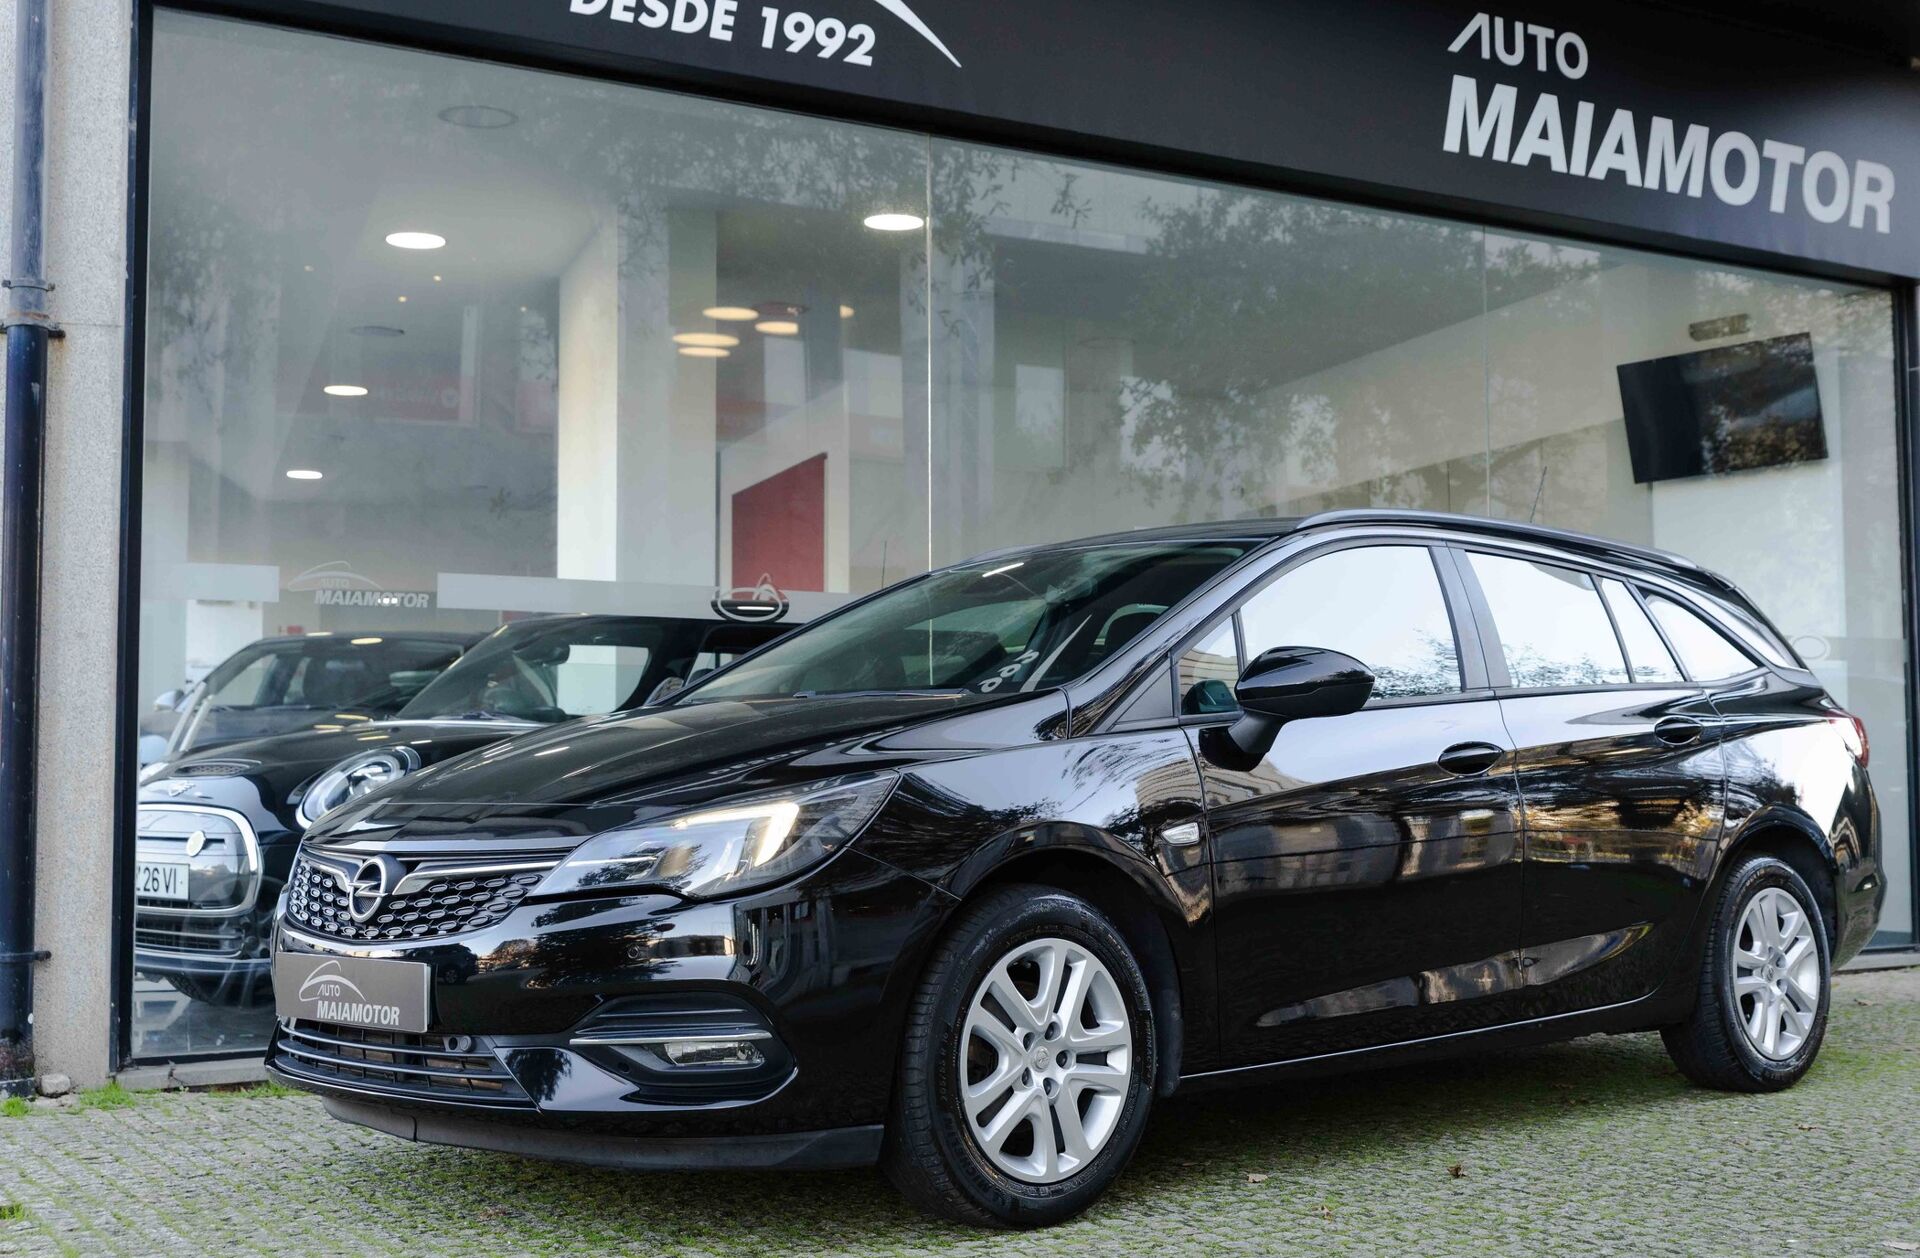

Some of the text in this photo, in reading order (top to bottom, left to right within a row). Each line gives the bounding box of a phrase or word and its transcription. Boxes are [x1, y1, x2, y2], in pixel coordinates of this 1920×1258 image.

[761, 6, 876, 66] 1992
[1447, 12, 1589, 80] AUTO
[1443, 74, 1896, 234] MAIAMOTOR
[314, 590, 430, 609] MAIAMOTOR
[143, 866, 160, 893] 26
[162, 867, 177, 894] VI
[317, 984, 341, 997] AUTO
[316, 1000, 401, 1026] MAIAMOTOR
